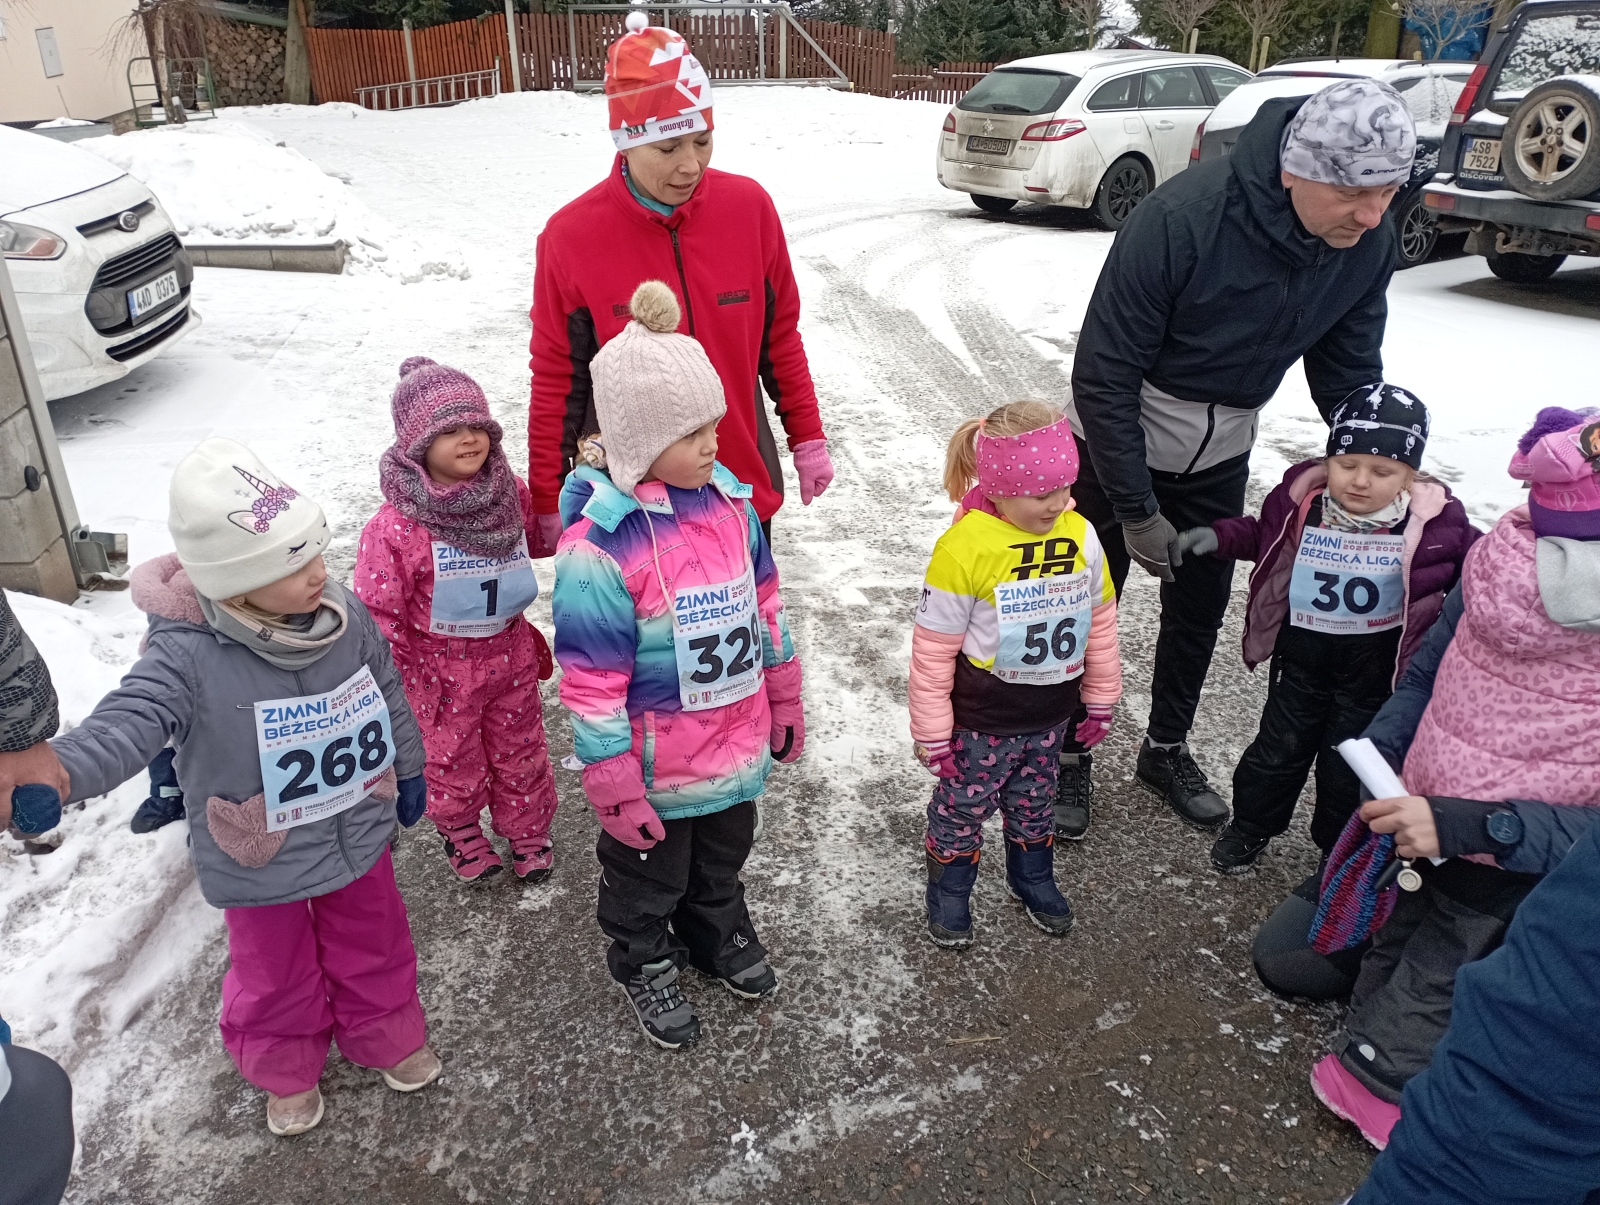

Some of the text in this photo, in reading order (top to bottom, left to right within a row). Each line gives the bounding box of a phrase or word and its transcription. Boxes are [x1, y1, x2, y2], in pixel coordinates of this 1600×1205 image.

[1472, 141, 1491, 154] 4S8
[1470, 155, 1495, 169] 7522
[1460, 172, 1504, 181] DISCOVERY
[136, 275, 176, 310] 4AD 0376
[437, 547, 472, 559] ZIM
[1007, 538, 1079, 564] TO
[1304, 533, 1342, 550] ZIMNÍ
[1343, 544, 1402, 552] 2025-2026
[1300, 546, 1402, 566] BĚŽECKÁ LIGA
[480, 579, 498, 616] 1
[676, 586, 729, 611] ZIMNÍ
[999, 582, 1046, 601] ZIMNÍ
[1310, 571, 1380, 614] 30
[677, 596, 748, 626] BĚŽECKÁ
[1002, 596, 1066, 614] BĚŽECKÁ
[689, 612, 762, 684] 329
[1021, 618, 1077, 665] 56
[332, 680, 373, 710] 2025-2026
[262, 697, 328, 724] ZIMNÍ
[264, 690, 380, 740] BĚŽECKÁ LIGA
[276, 720, 388, 804] 268
